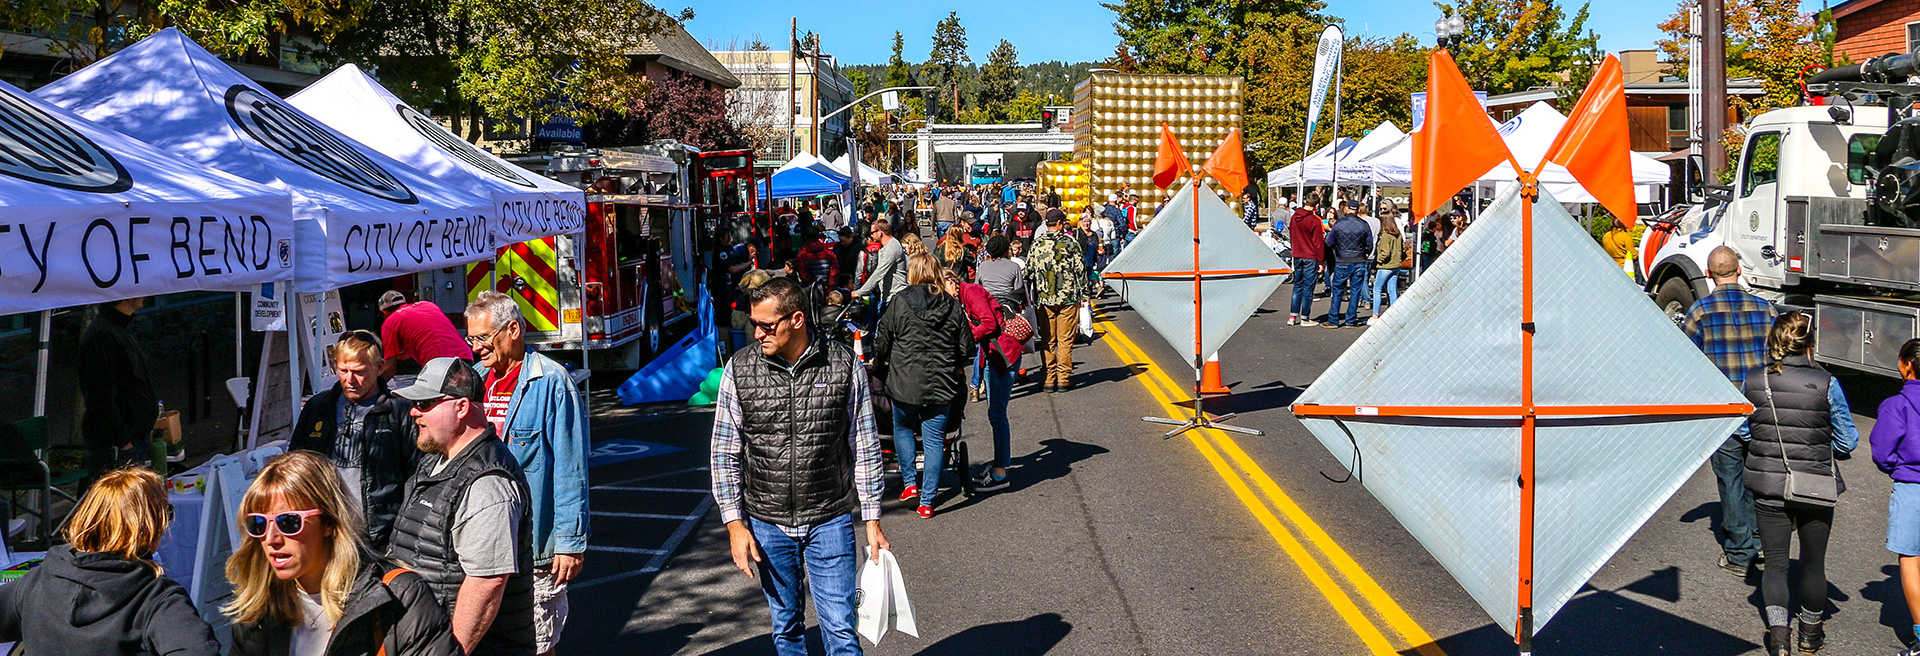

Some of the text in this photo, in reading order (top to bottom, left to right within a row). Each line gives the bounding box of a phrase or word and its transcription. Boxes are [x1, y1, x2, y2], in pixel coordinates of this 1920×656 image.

[538, 128, 580, 139] Available
[548, 114, 578, 126] arking
[501, 199, 582, 237] CITY OF BEND
[81, 216, 151, 289] OF
[170, 214, 271, 279] BEND
[344, 214, 487, 273] CITY OF BEND
